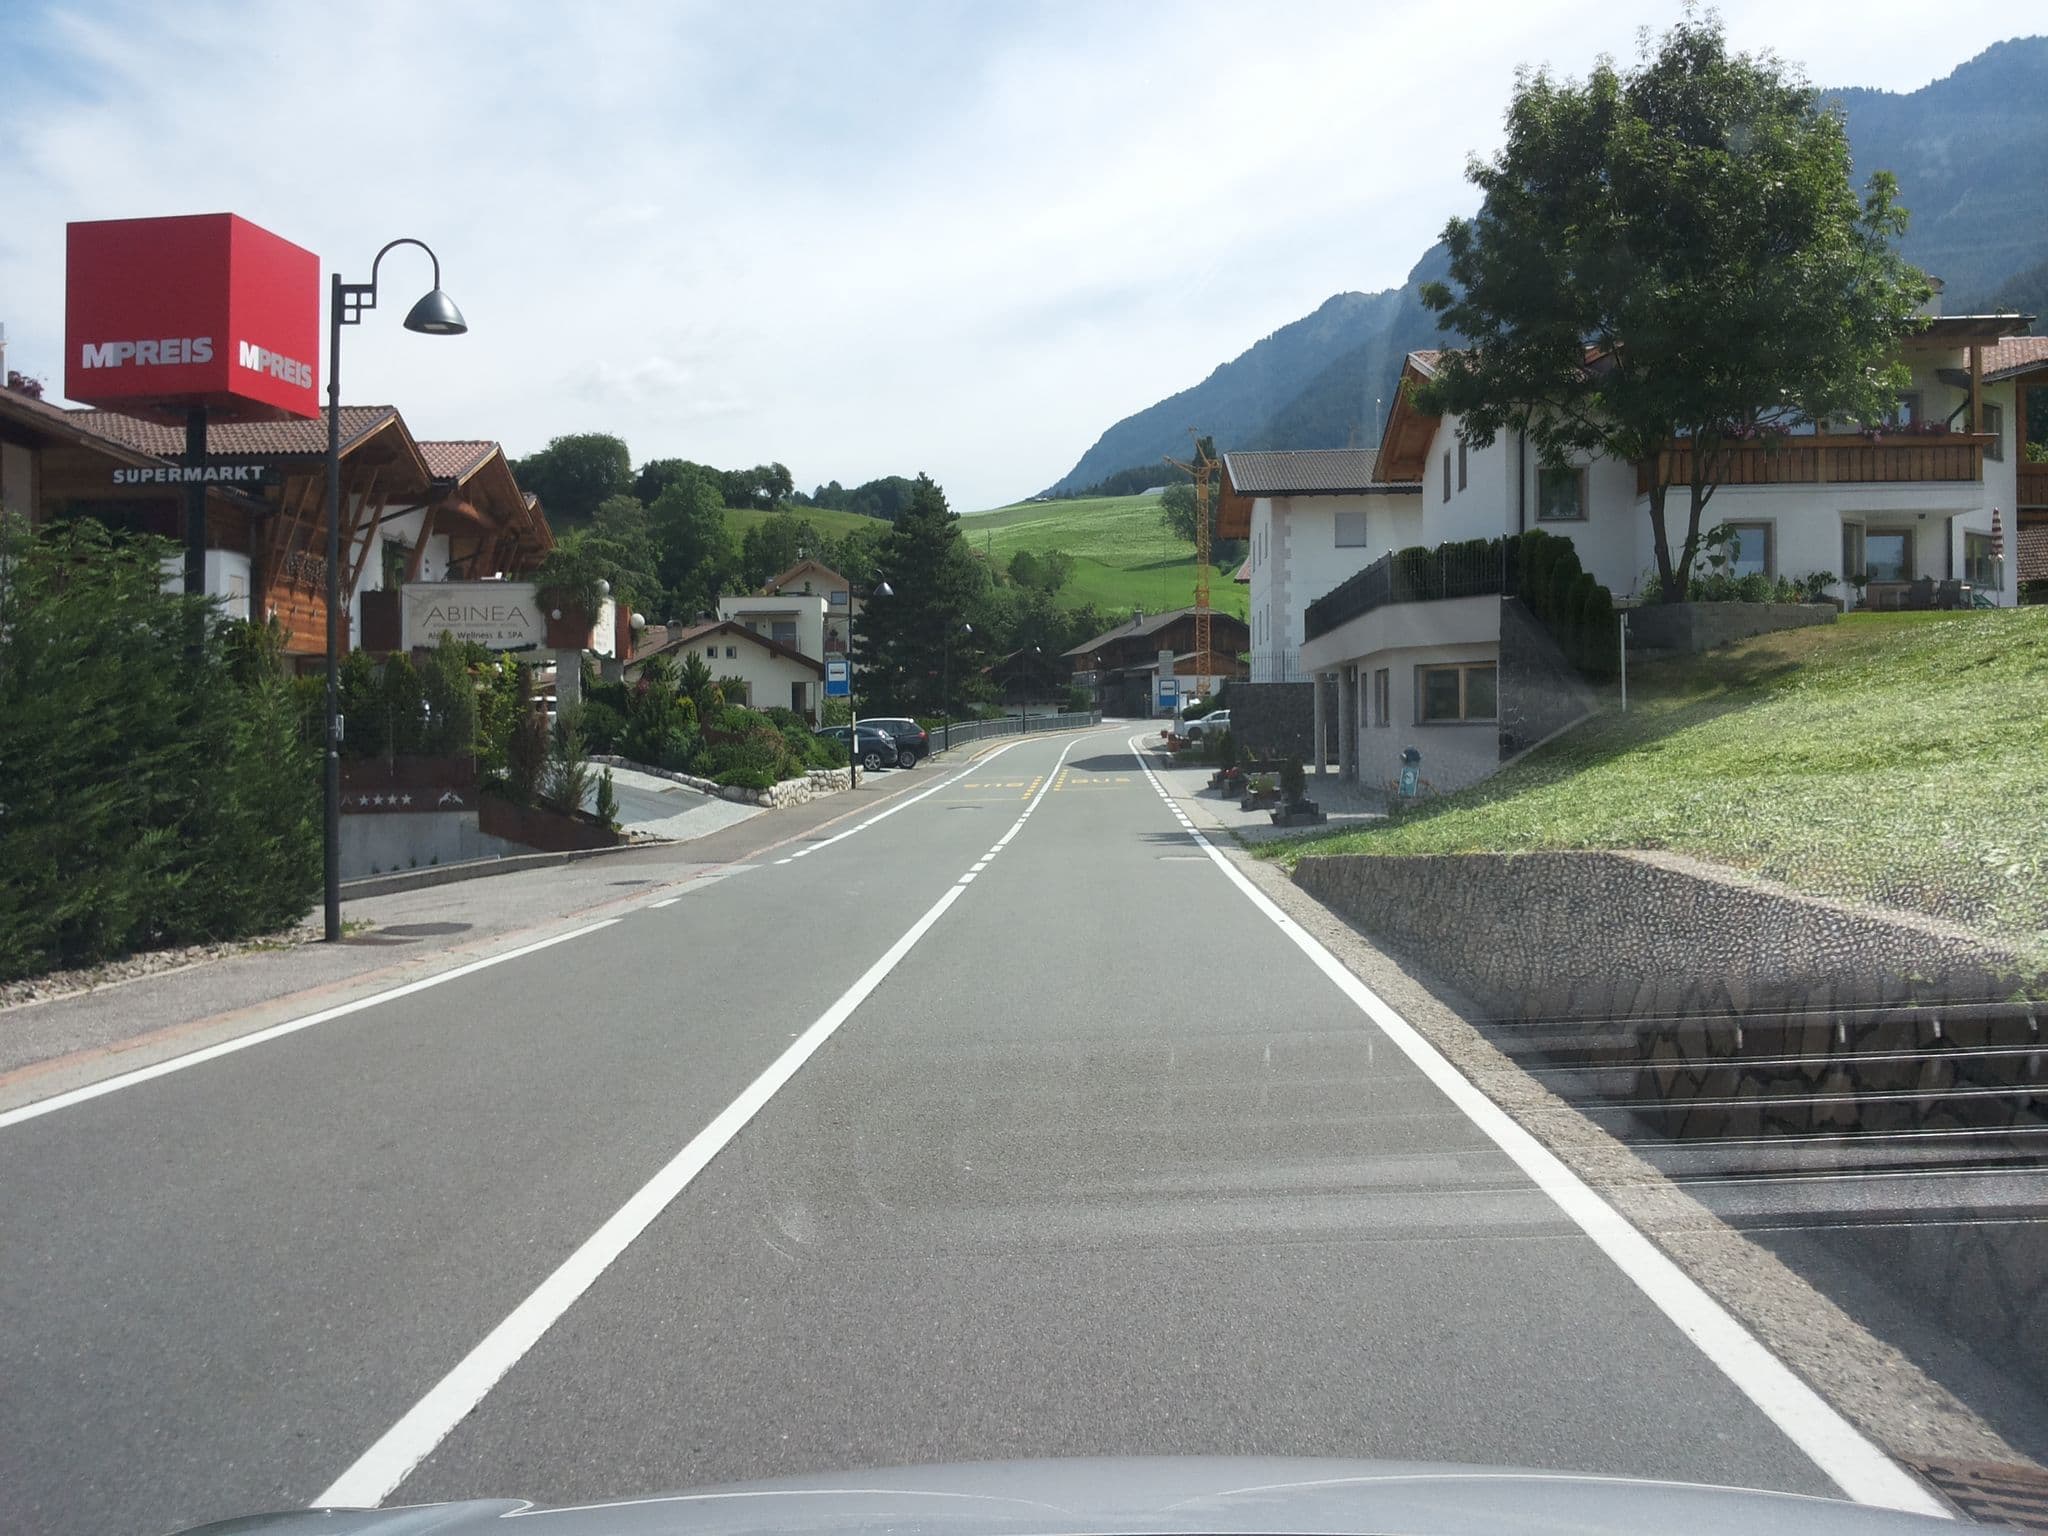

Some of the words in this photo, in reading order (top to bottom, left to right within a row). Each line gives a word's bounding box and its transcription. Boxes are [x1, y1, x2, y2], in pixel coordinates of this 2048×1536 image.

[82, 337, 213, 369] MPREIS
[239, 341, 312, 389] MPREIS
[113, 465, 264, 484] SUPERMARKT
[423, 606, 530, 627] ABINEA
[457, 631, 493, 640] Wellness
